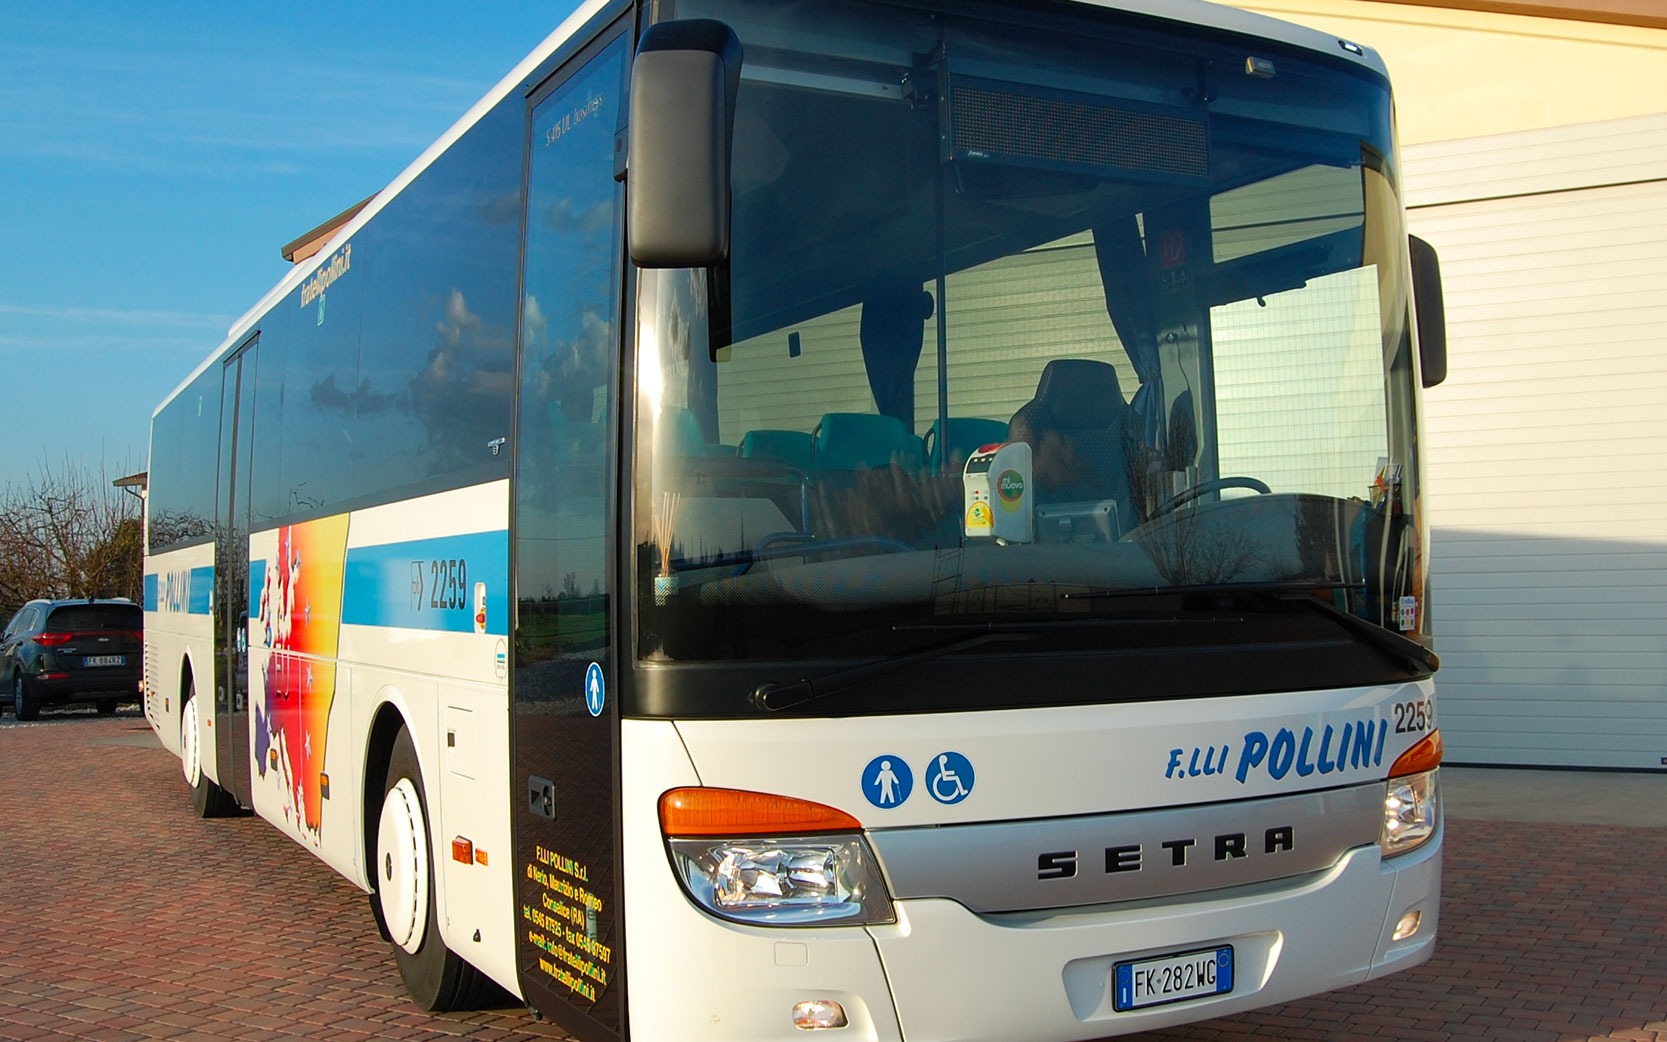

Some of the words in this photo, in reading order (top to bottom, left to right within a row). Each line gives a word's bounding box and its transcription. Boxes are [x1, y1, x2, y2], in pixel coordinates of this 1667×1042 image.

[431, 558, 466, 610] 2259
[1394, 700, 1434, 734] 2259
[1164, 744, 1229, 779] F.LLI
[1235, 718, 1388, 784] POLLINI
[549, 851, 574, 876] POLLINI
[574, 861, 589, 882] S.r.l.
[1037, 825, 1295, 881] SETRA
[526, 863, 532, 879] di
[549, 873, 573, 899] Maurizio
[574, 888, 579, 901] e
[579, 887, 602, 912] Romeo
[532, 908, 545, 928] 0545
[542, 892, 570, 920] Conselice
[570, 906, 585, 931] (RA)
